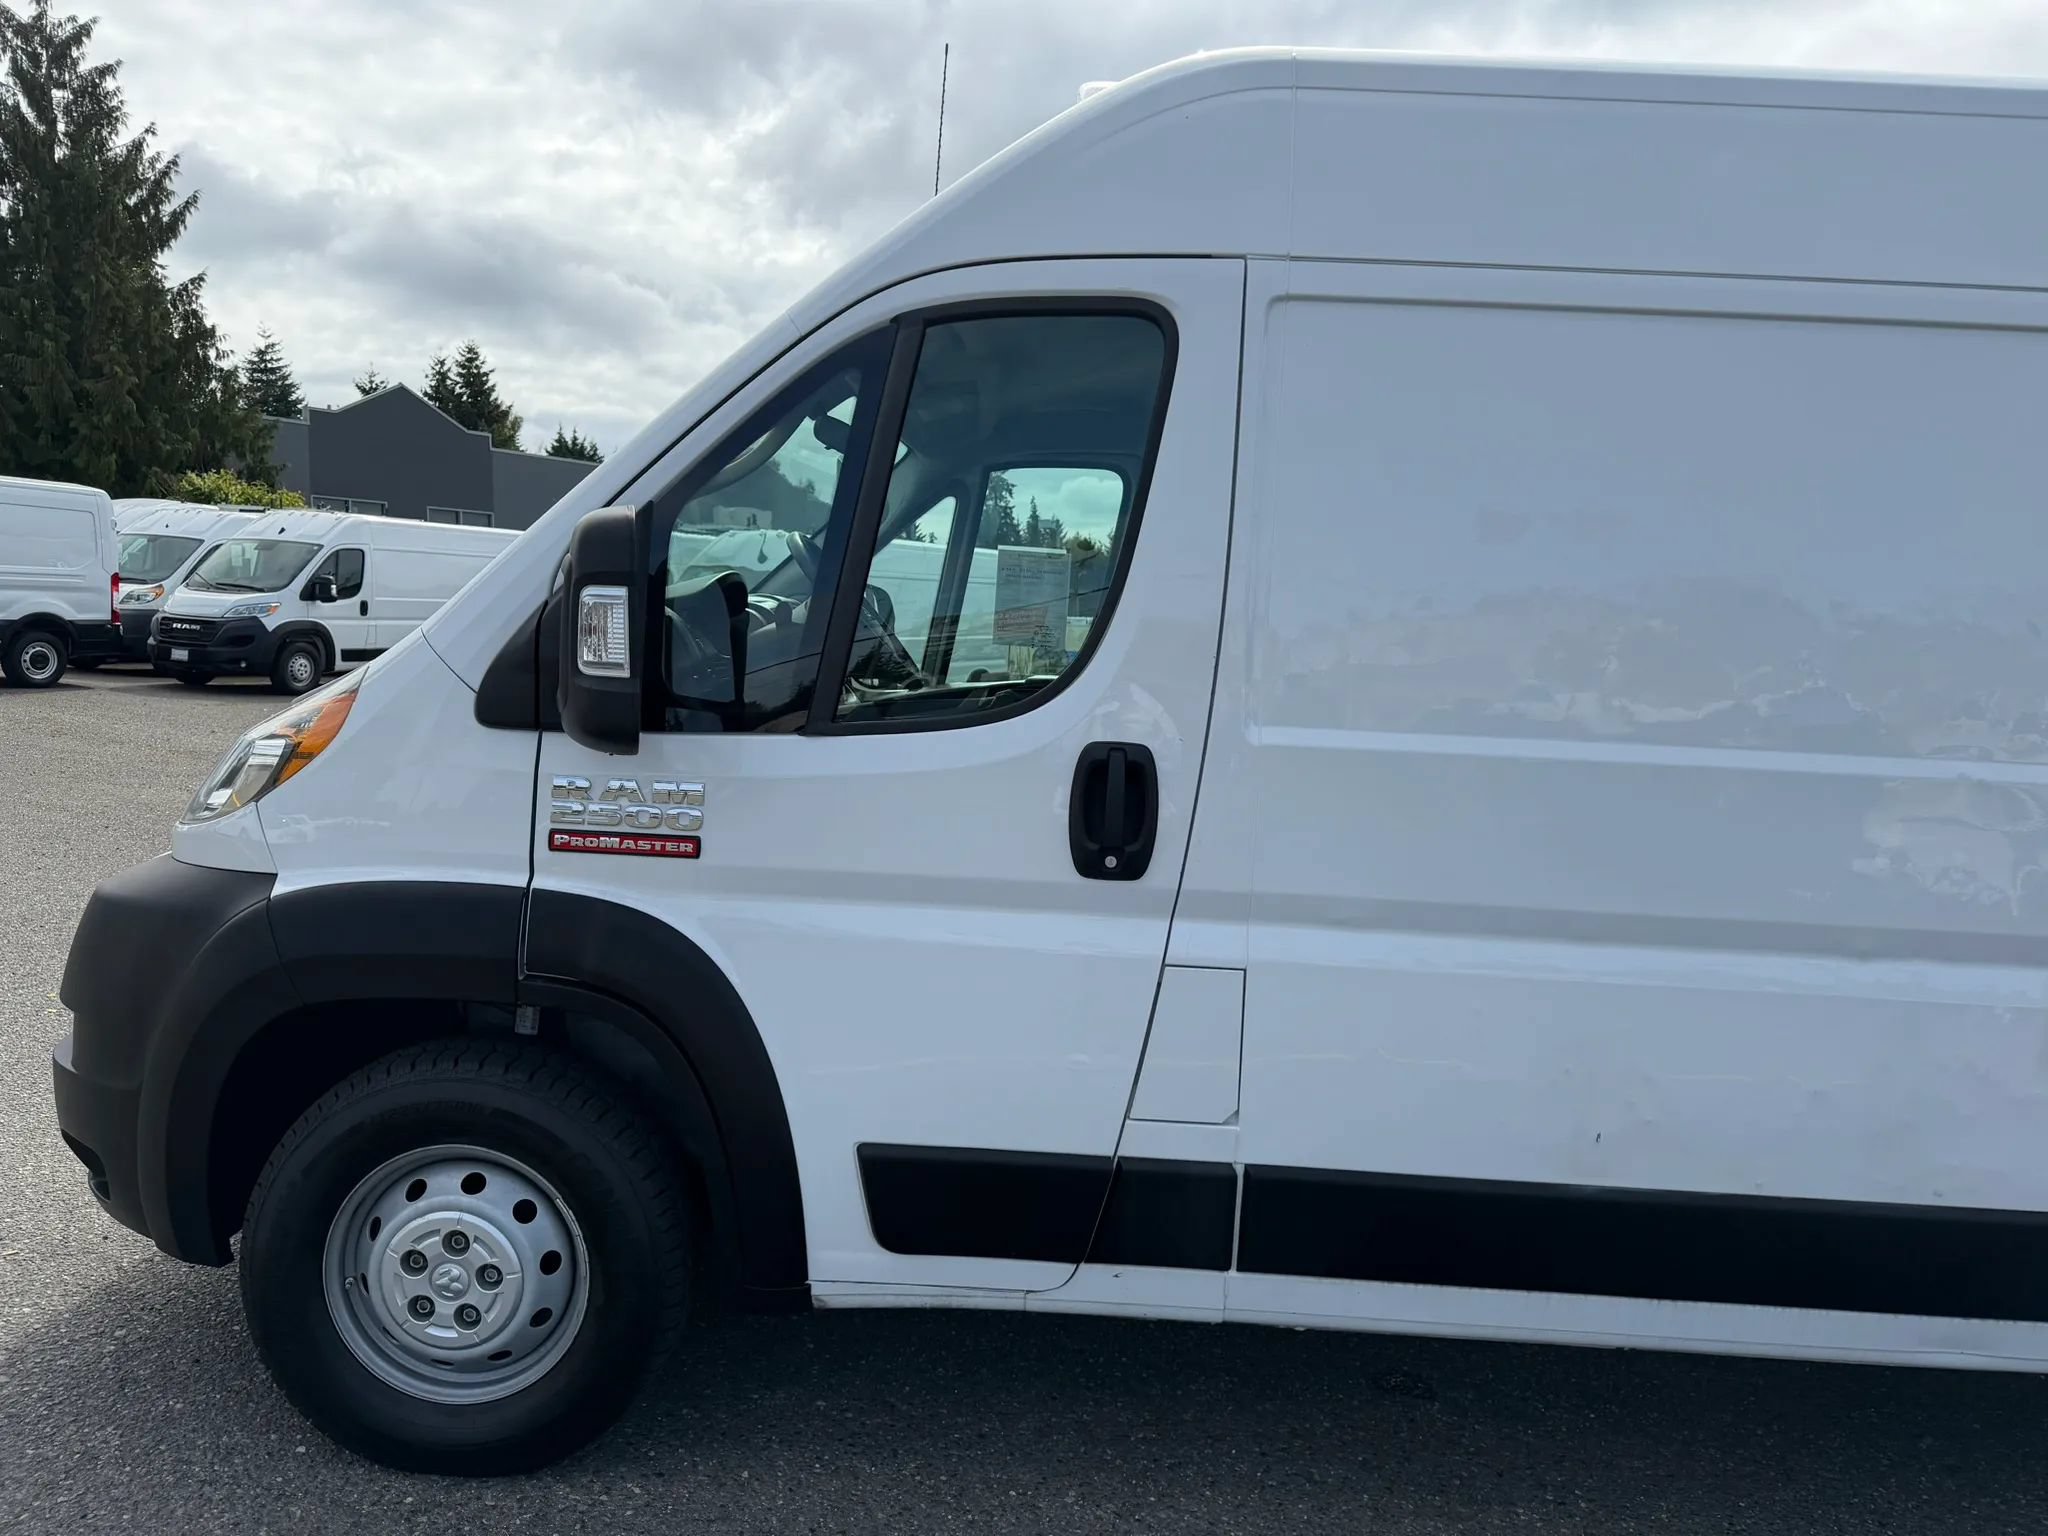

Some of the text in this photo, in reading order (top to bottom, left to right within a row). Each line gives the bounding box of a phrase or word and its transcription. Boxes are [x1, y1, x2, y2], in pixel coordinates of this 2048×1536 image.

[172, 622, 201, 631] RAM
[551, 775, 705, 805] RAM
[550, 801, 704, 831] 2500
